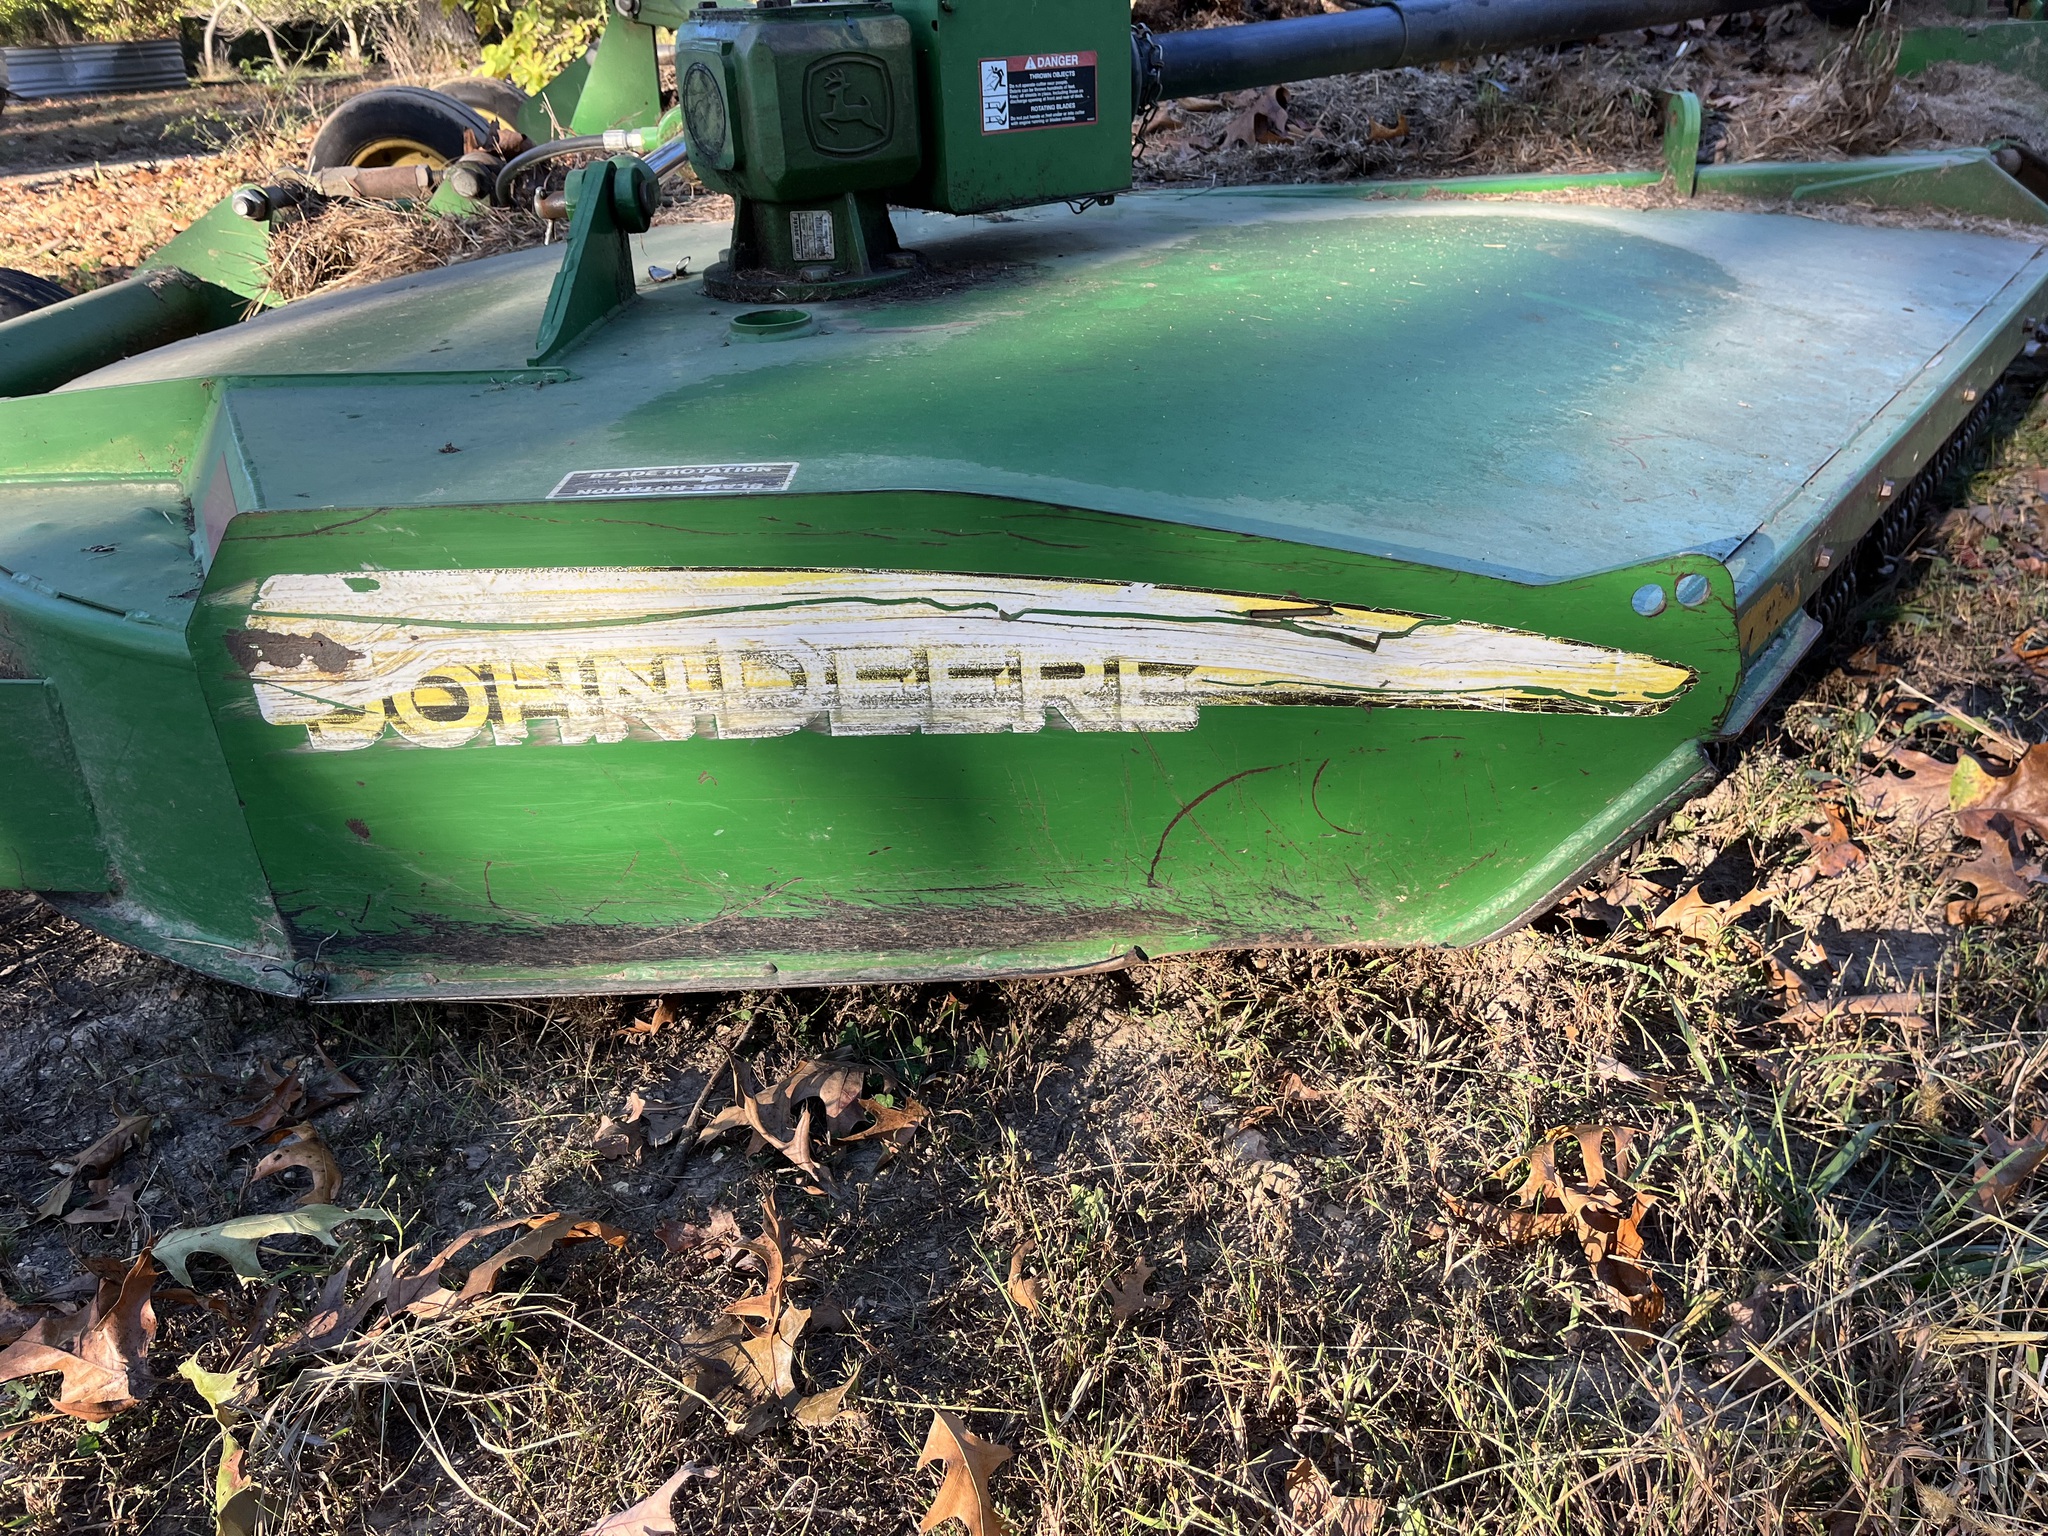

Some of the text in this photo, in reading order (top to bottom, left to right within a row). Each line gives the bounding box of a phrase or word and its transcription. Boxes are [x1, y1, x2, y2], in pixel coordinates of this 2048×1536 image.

[1037, 55, 1078, 67] DANGER
[588, 466, 774, 479] BLADE ROTATION
